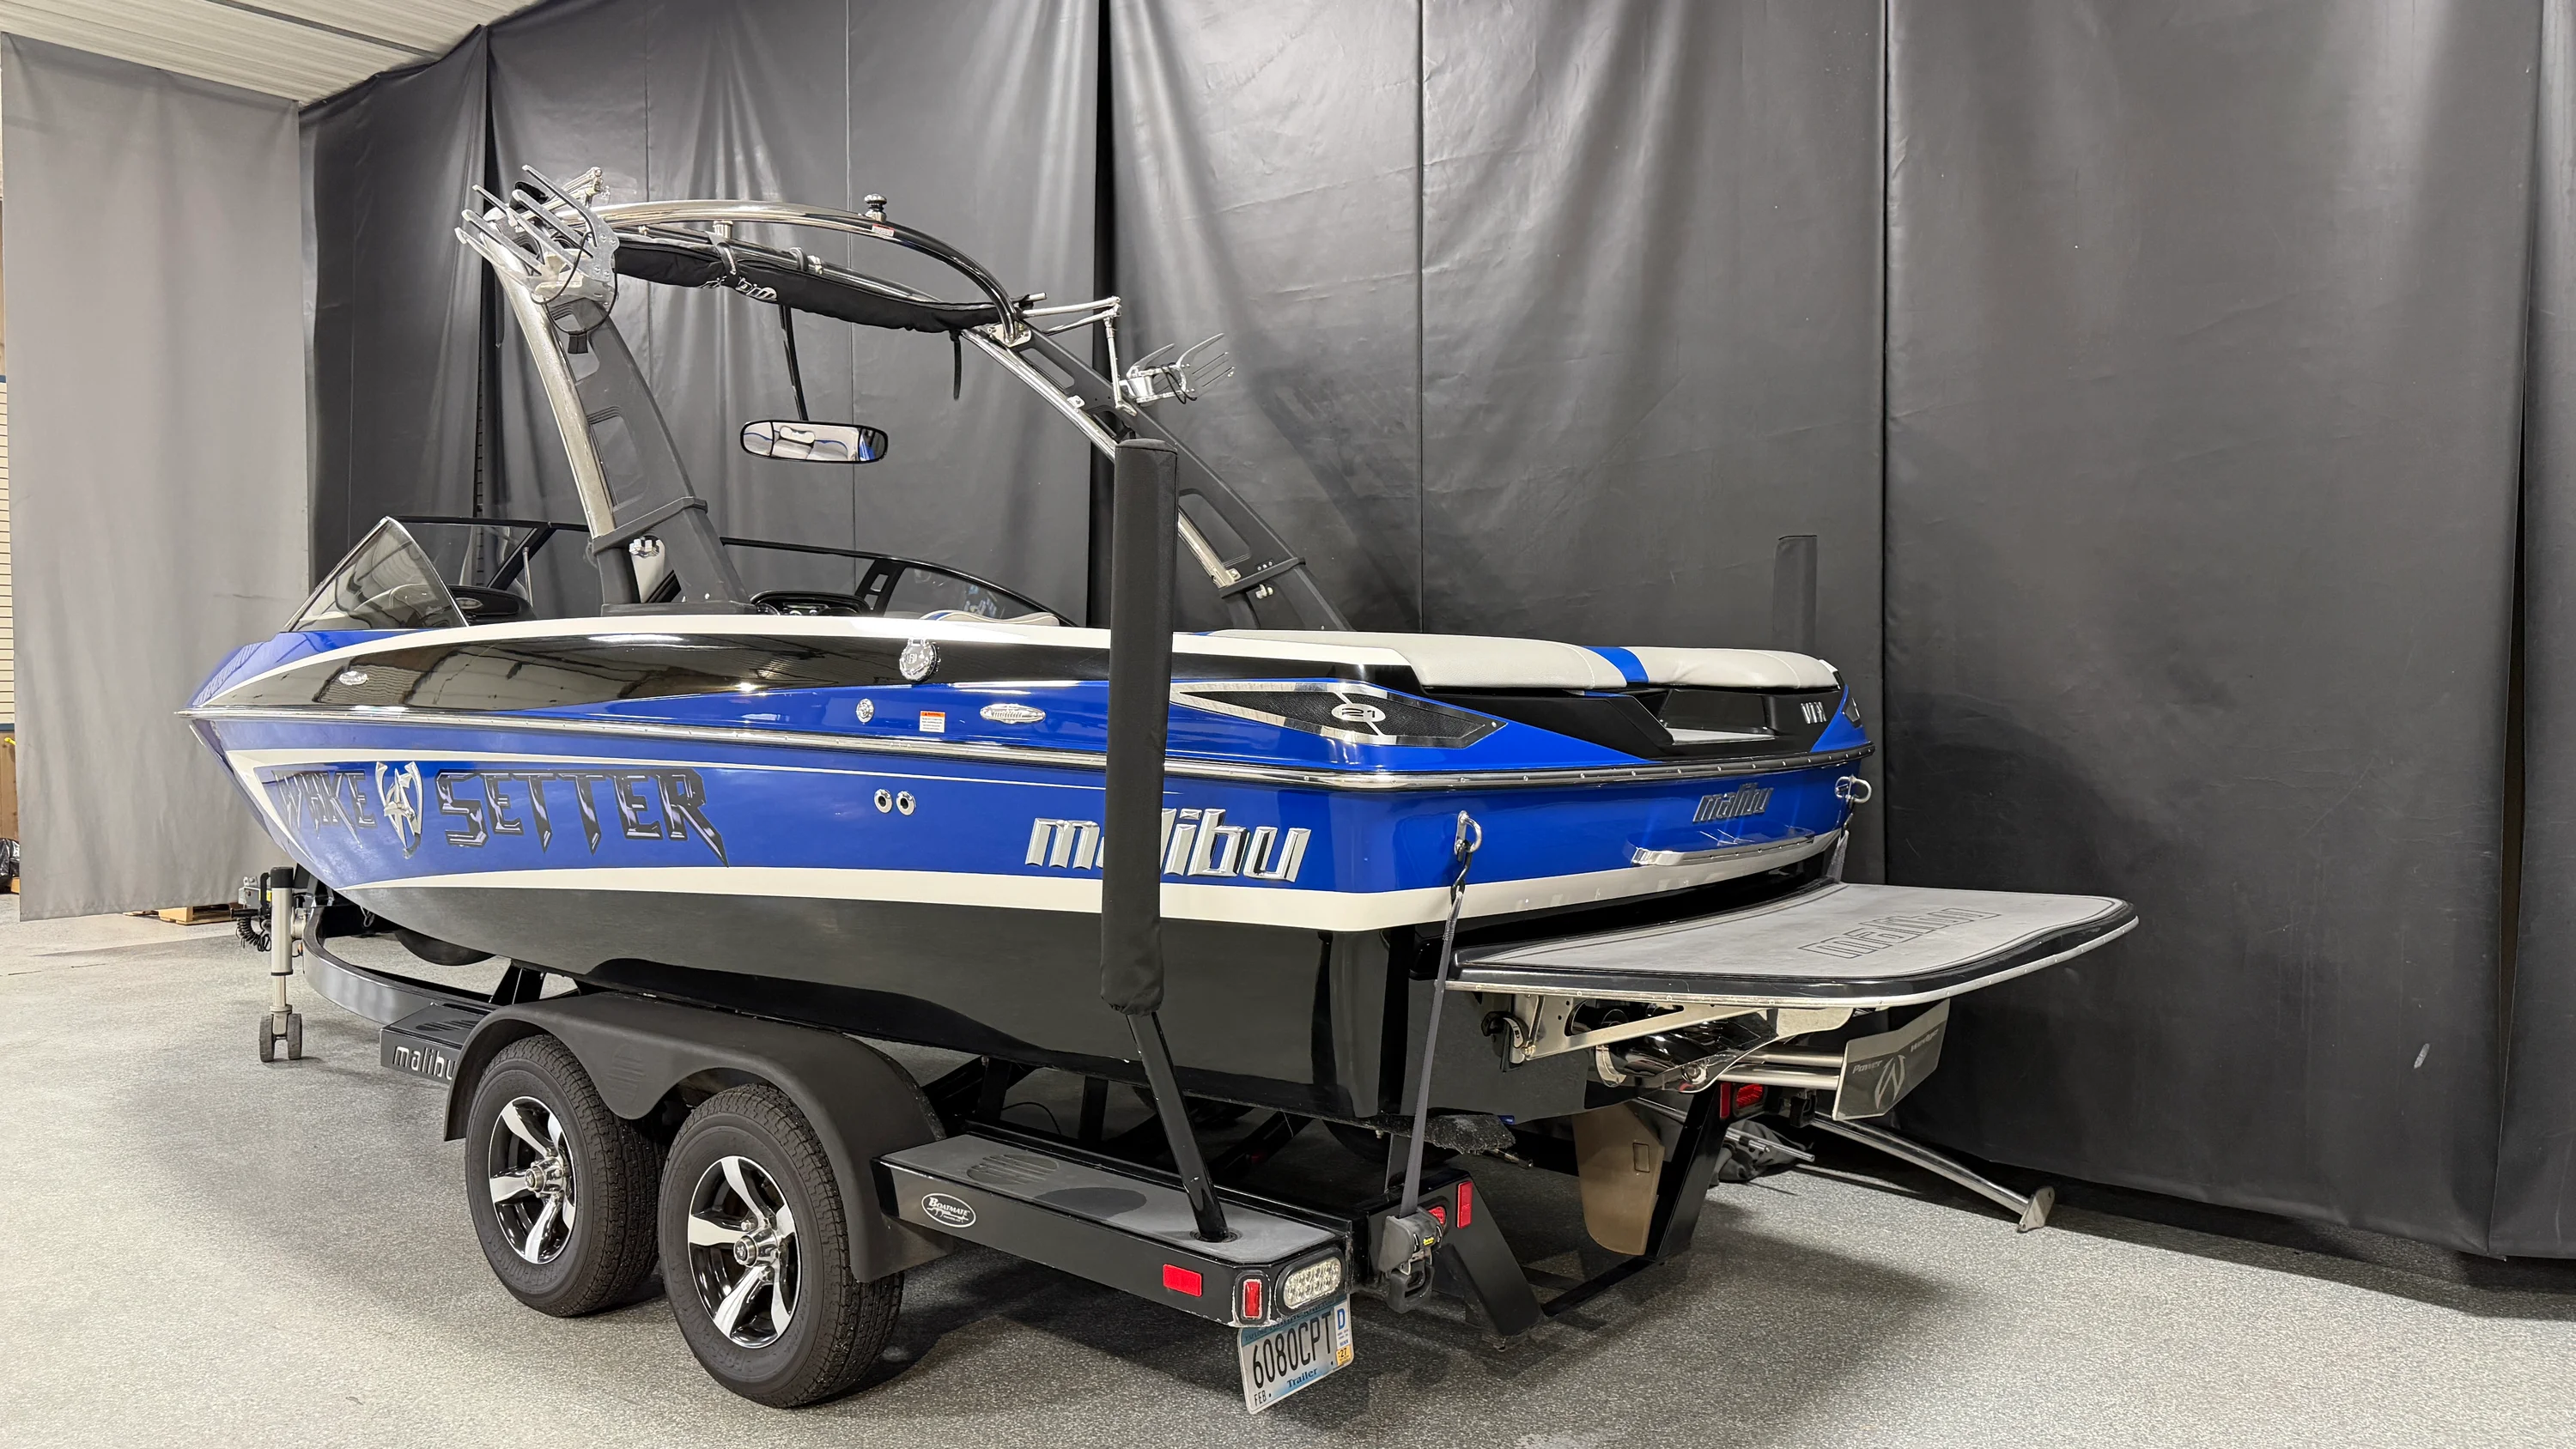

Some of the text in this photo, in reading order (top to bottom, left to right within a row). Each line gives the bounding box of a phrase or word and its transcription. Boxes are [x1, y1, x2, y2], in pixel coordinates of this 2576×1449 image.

[1341, 707, 1376, 719] 21
[436, 767, 729, 868] SETTER
[1692, 782, 1775, 824] malibu
[1024, 807, 1312, 883] mibu
[1797, 906, 2002, 960] malibu
[392, 1046, 457, 1081] malibu
[1336, 1307, 1346, 1331] D
[1252, 1310, 1332, 1390] 6080CPT
[1286, 1367, 1319, 1389] Trailer
